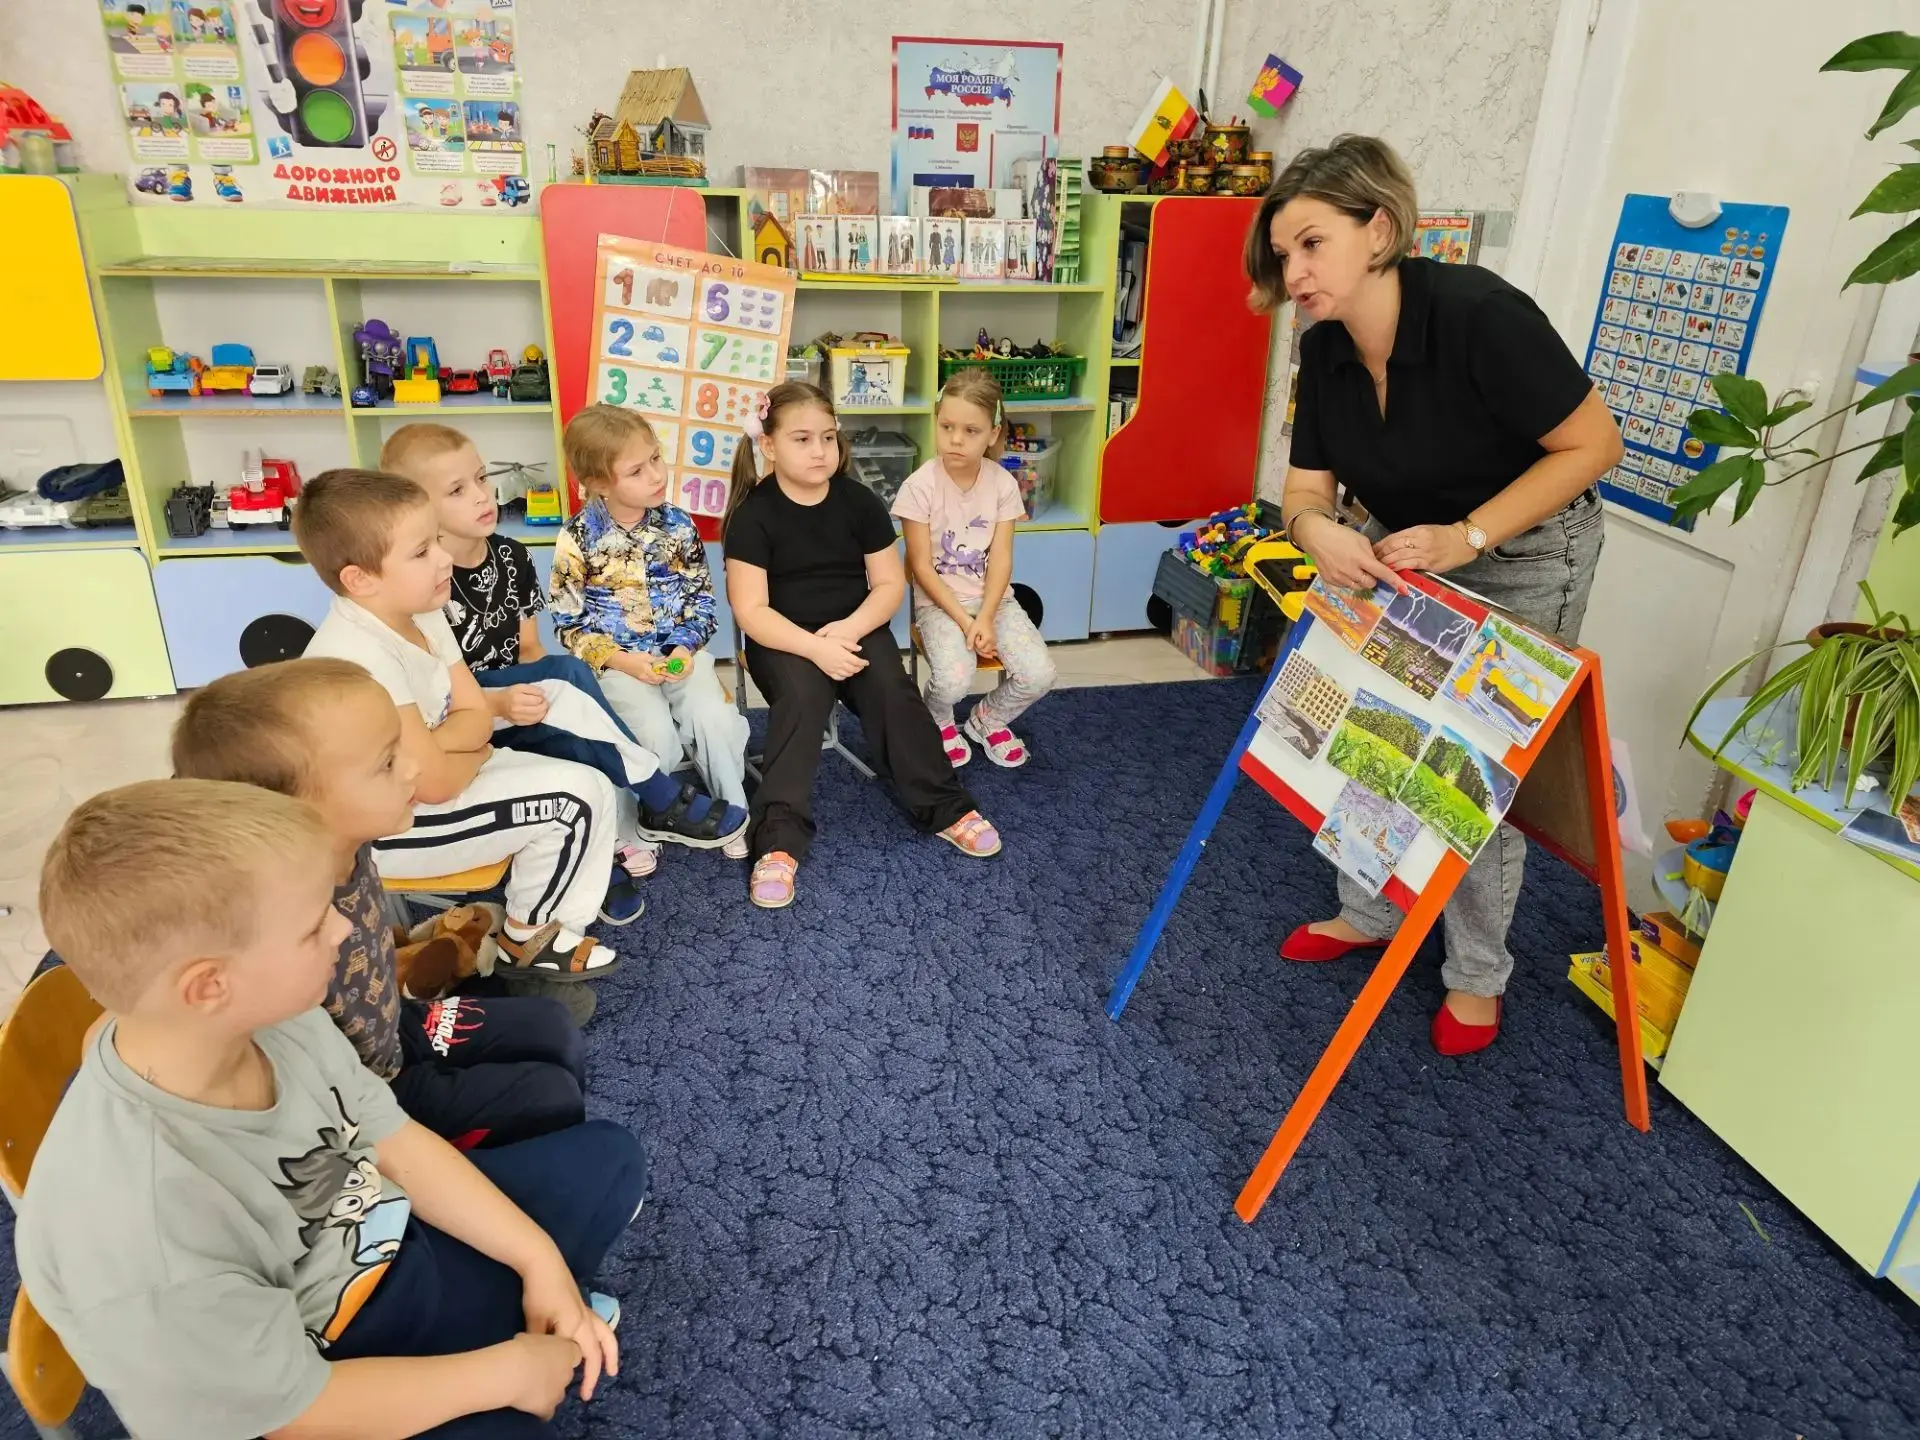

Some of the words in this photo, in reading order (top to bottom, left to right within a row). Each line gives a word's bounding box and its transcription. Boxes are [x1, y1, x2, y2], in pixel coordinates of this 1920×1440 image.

[936, 74, 959, 83] МОЯ
[961, 75, 1004, 85] РОДИНА
[951, 84, 992, 95] РОССИЯ
[273, 164, 400, 184] ДОРОЖНОГО
[286, 184, 397, 204] ДВИЖЕНИЯ
[1645, 249, 1653, 261] Б
[1672, 253, 1682, 265] В
[655, 252, 693, 269] СЧЕТ
[702, 262, 722, 275] ДО
[731, 265, 744, 278] 10
[1731, 262, 1742, 277] Д
[613, 268, 634, 305] 1
[1664, 281, 1676, 294] Ж
[706, 283, 730, 322] 6
[1724, 292, 1735, 305] И
[1631, 304, 1639, 317] К
[1659, 310, 1668, 323] Л
[1687, 316, 1697, 329] М
[1718, 321, 1727, 335] Н
[608, 318, 635, 356] 2
[1624, 332, 1632, 344] П
[1651, 338, 1660, 350] Р
[700, 333, 727, 370] 7
[1681, 344, 1690, 356] С
[1712, 350, 1720, 363] Т
[1645, 365, 1654, 378] Х
[605, 368, 627, 405] 3
[1672, 372, 1681, 387] Ц
[1610, 383, 1620, 398] Щ
[696, 382, 719, 419] 8
[1663, 399, 1676, 413] Ы
[1627, 417, 1640, 430] Ю
[1655, 426, 1665, 438] Я
[692, 430, 715, 466] 9
[682, 477, 726, 513] 10
[432, 996, 460, 1057] SPIDER-M
